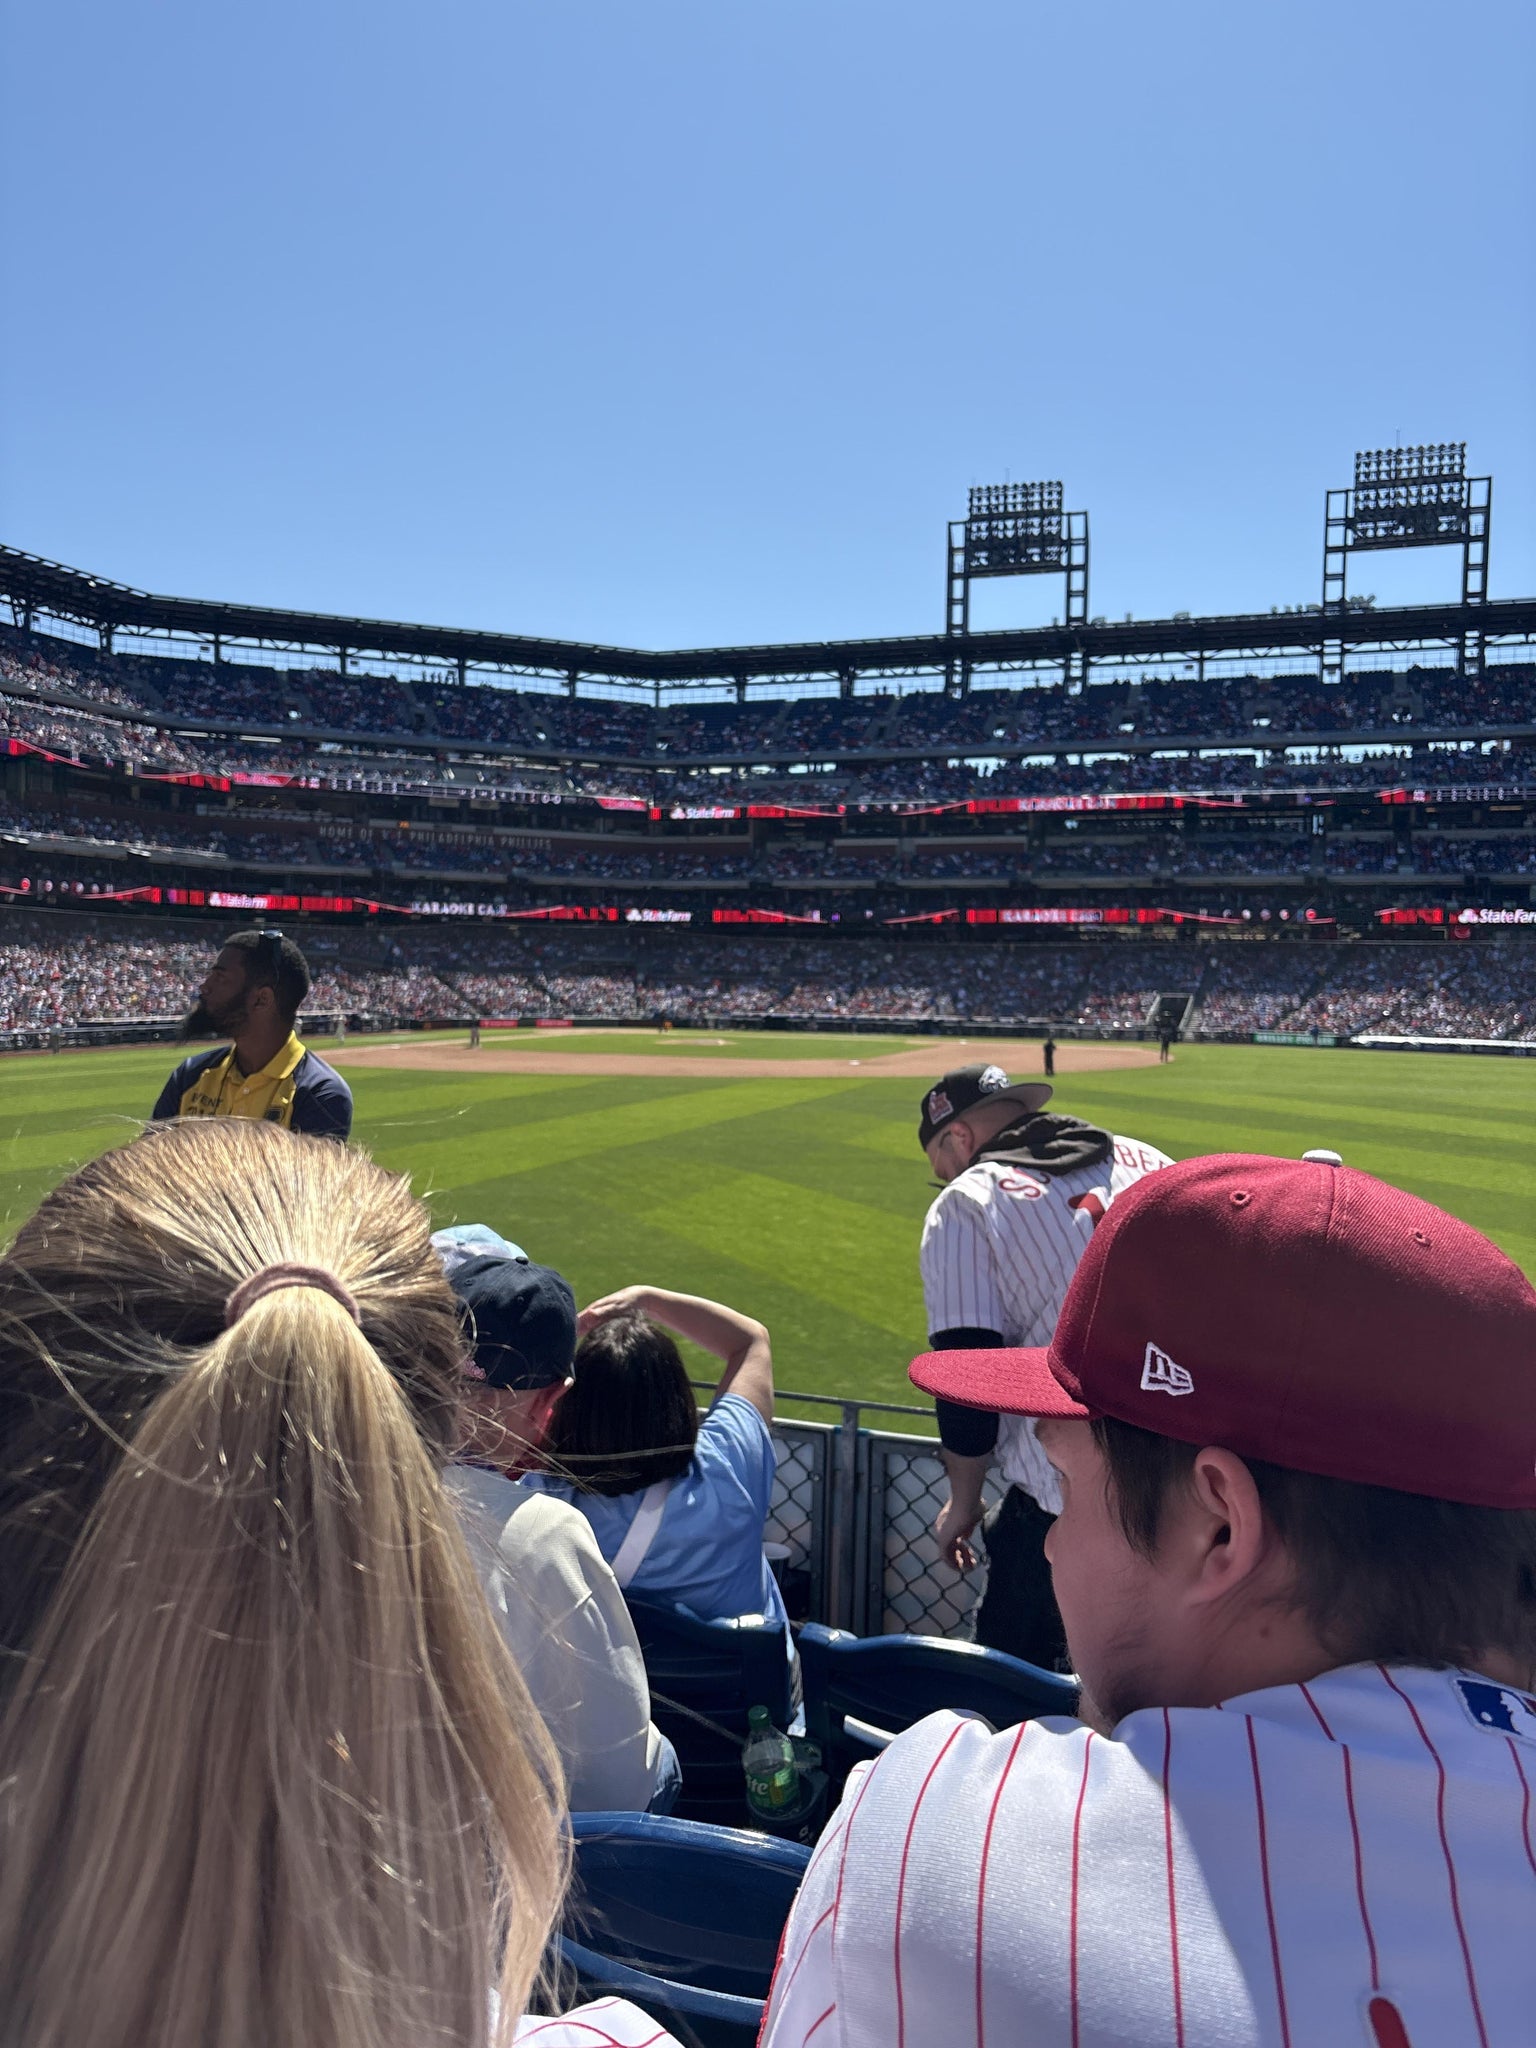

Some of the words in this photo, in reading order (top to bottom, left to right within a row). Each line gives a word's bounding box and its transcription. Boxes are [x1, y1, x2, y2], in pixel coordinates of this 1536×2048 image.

[319, 826, 353, 840] HOME
[410, 830, 495, 847] PHILADELPHIA
[500, 836, 552, 850] PHILLIES
[411, 901, 475, 916] KARAOKE
[1479, 908, 1536, 924] StateFar
